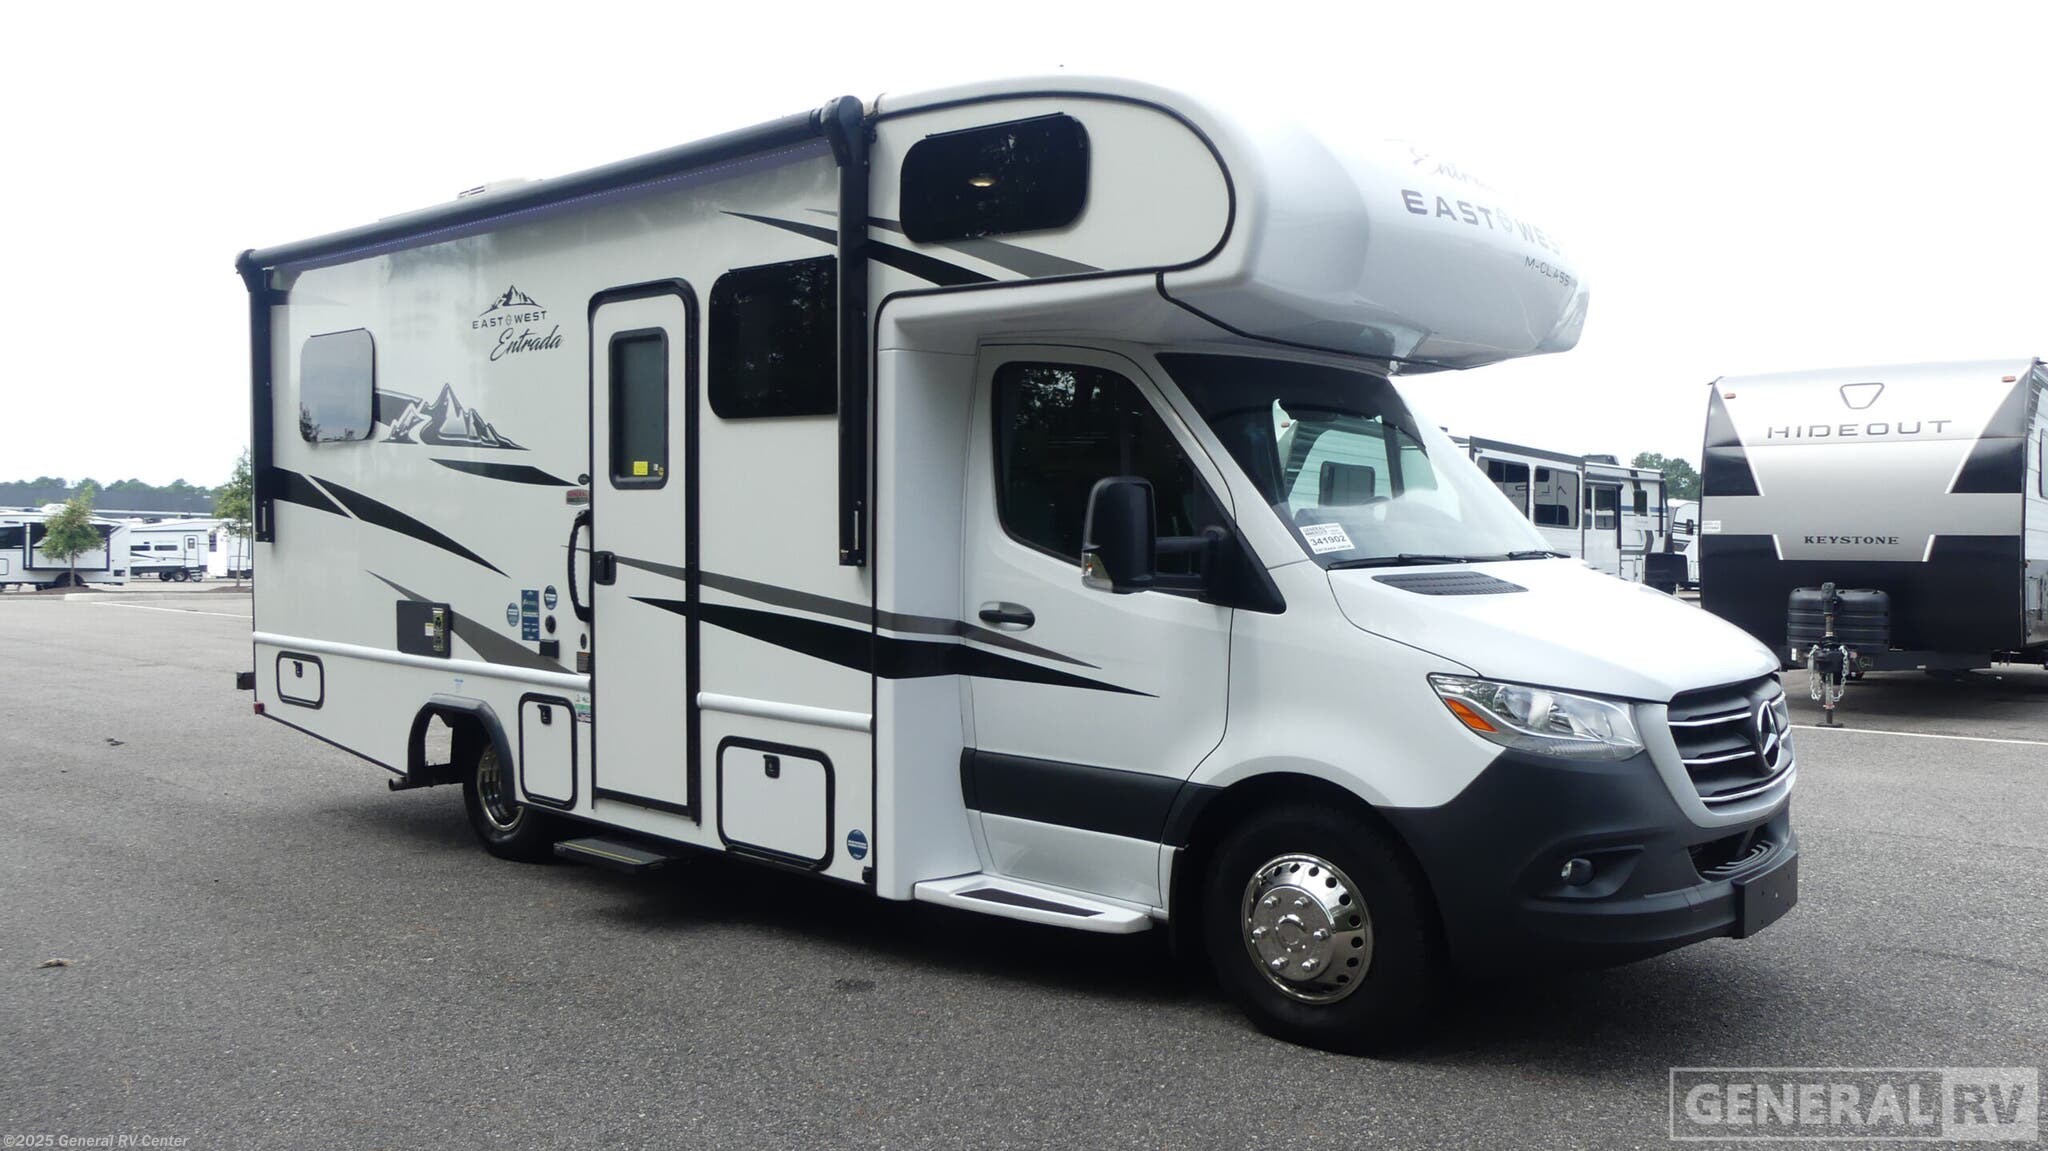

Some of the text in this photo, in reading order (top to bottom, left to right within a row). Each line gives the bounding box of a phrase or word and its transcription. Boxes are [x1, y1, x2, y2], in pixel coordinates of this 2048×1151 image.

[1401, 188, 1567, 257] EAST WES
[1524, 255, 1570, 287] M-CLASS
[472, 310, 548, 330] EAST WEST
[490, 324, 562, 362] Entrada
[1767, 419, 1952, 439] HIDEOUT
[1803, 535, 1899, 545] KEYSTONE
